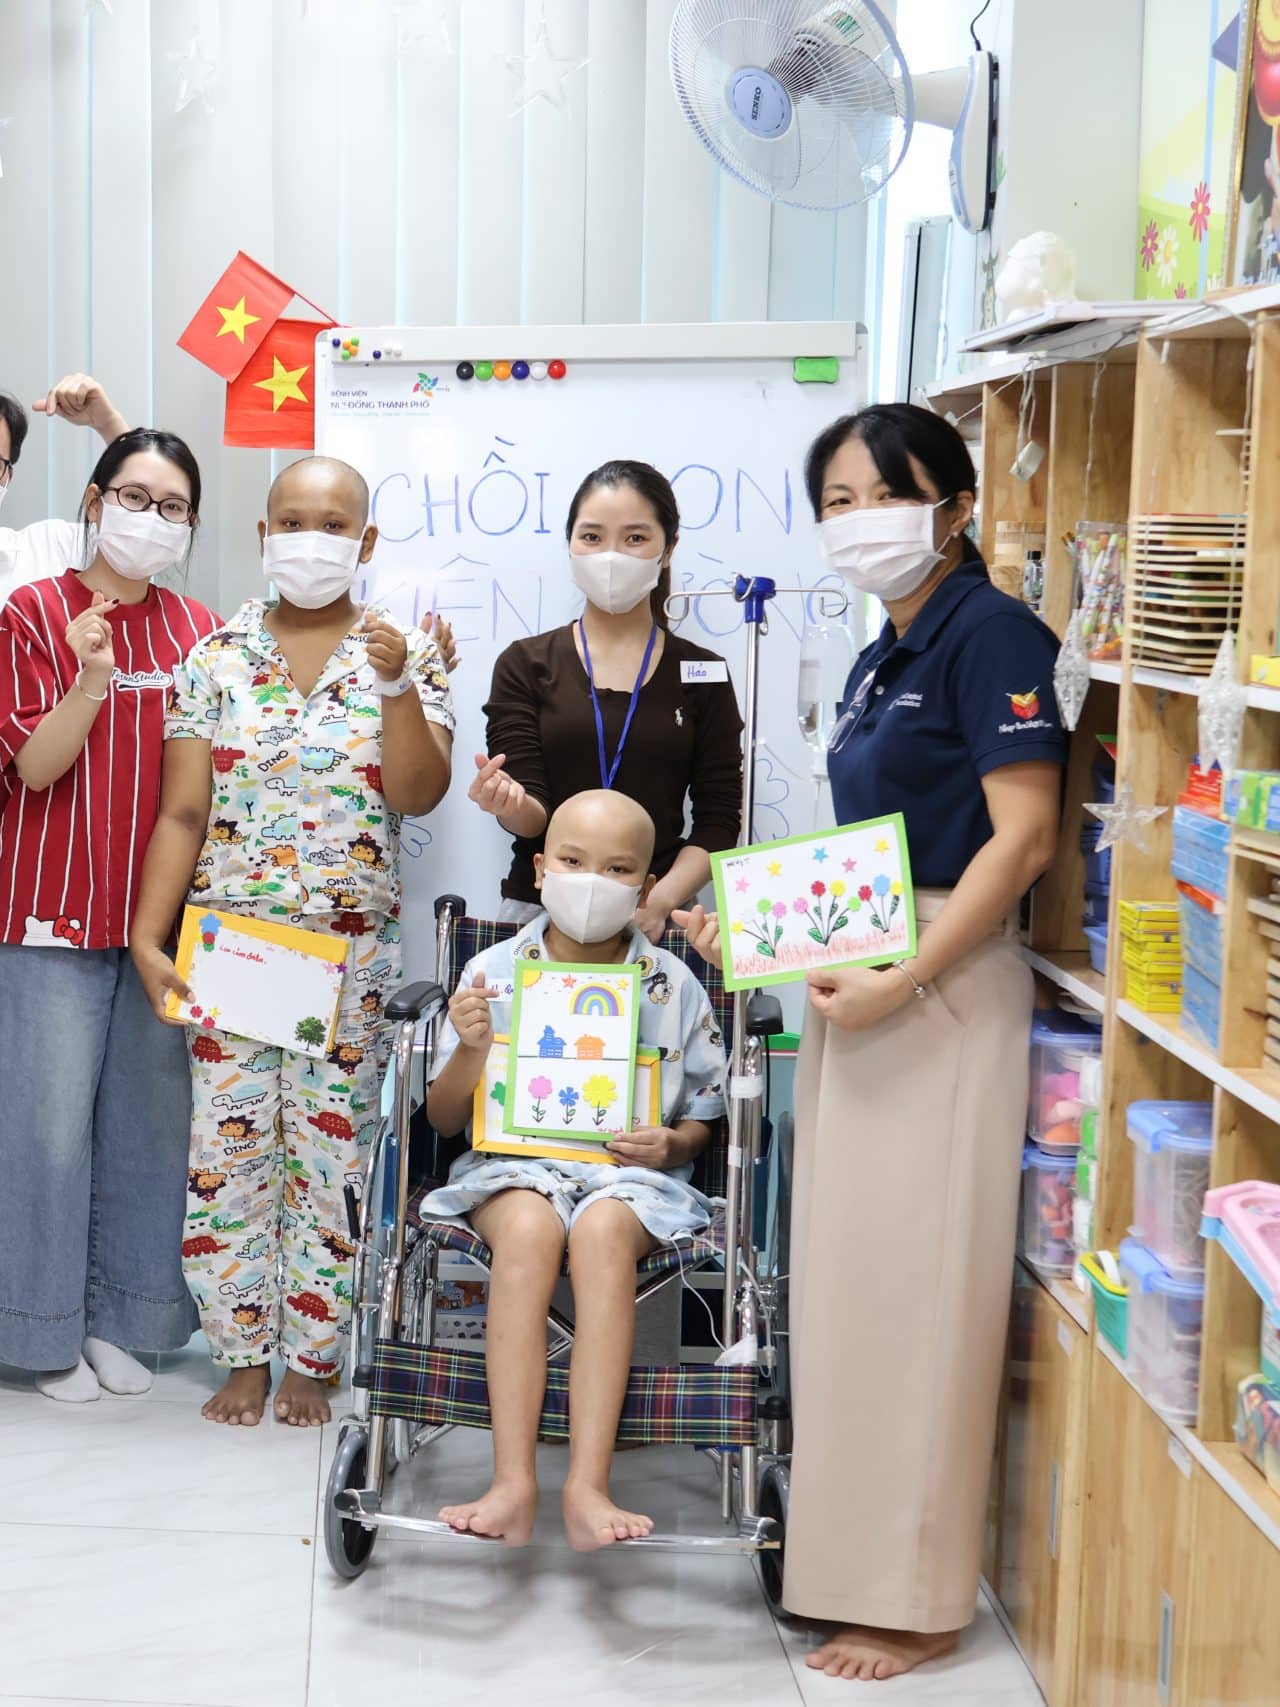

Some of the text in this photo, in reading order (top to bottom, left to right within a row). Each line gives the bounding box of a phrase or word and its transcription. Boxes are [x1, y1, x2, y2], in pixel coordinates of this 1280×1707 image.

[751, 86, 762, 121] SENKO
[371, 435, 793, 543] CHỒI ON
[257, 750, 289, 773] DINO
[326, 878, 357, 887] DINO
[224, 1142, 256, 1156] DINO
[241, 1324, 268, 1341] DINO
